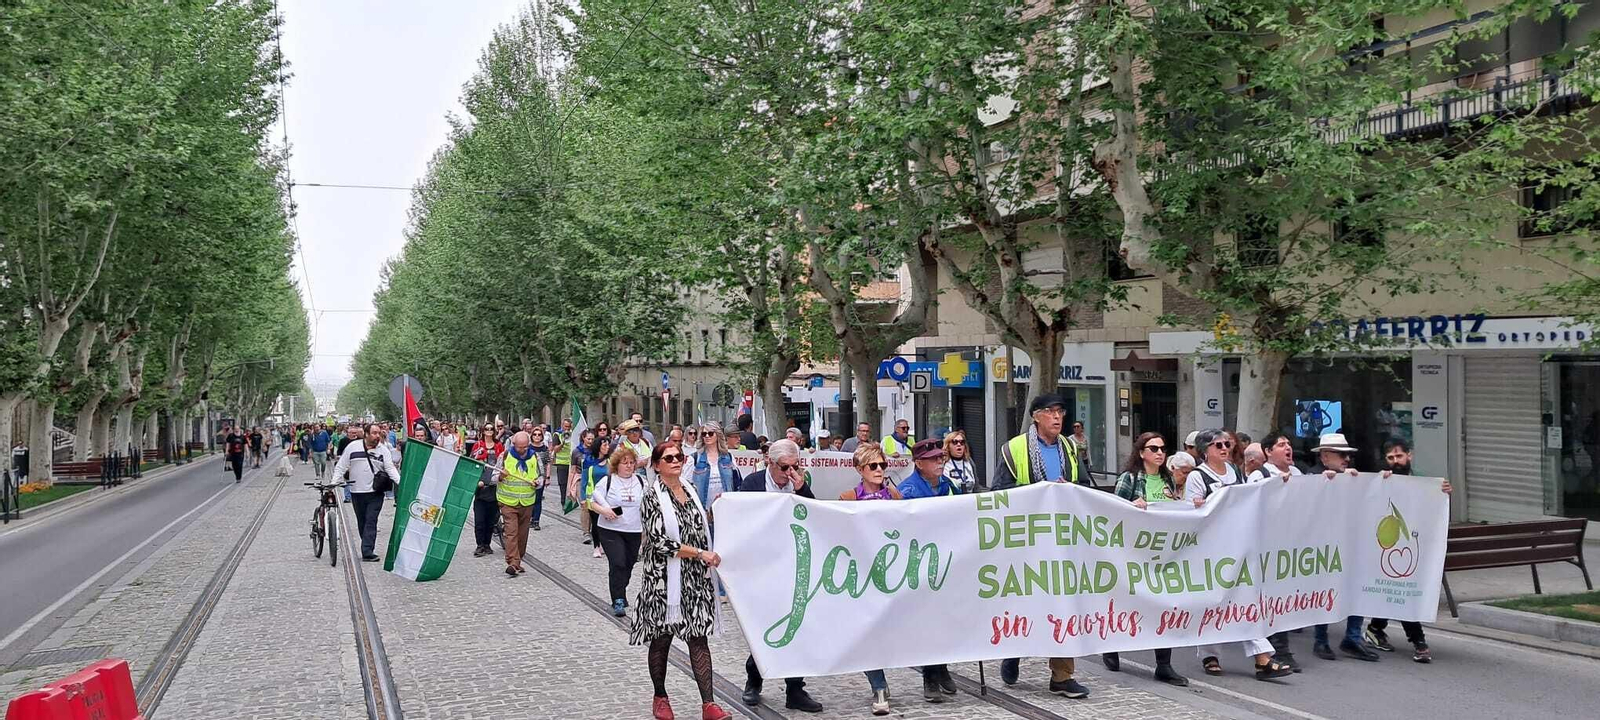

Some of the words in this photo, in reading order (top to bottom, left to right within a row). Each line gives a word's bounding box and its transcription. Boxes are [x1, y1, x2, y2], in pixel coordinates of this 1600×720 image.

[914, 374, 927, 390] D
[811, 458, 839, 468] SISTEMA
[976, 491, 1010, 511] EN
[978, 512, 1125, 551] DEFENSA
[1134, 530, 1168, 551] DE
[978, 558, 1119, 599] SANIDAD
[1126, 554, 1254, 596] PÚBLICA
[1259, 551, 1271, 584] Y
[1275, 545, 1343, 581] DIGNA
[990, 610, 1034, 646] sin
[1155, 606, 1194, 637] sin
